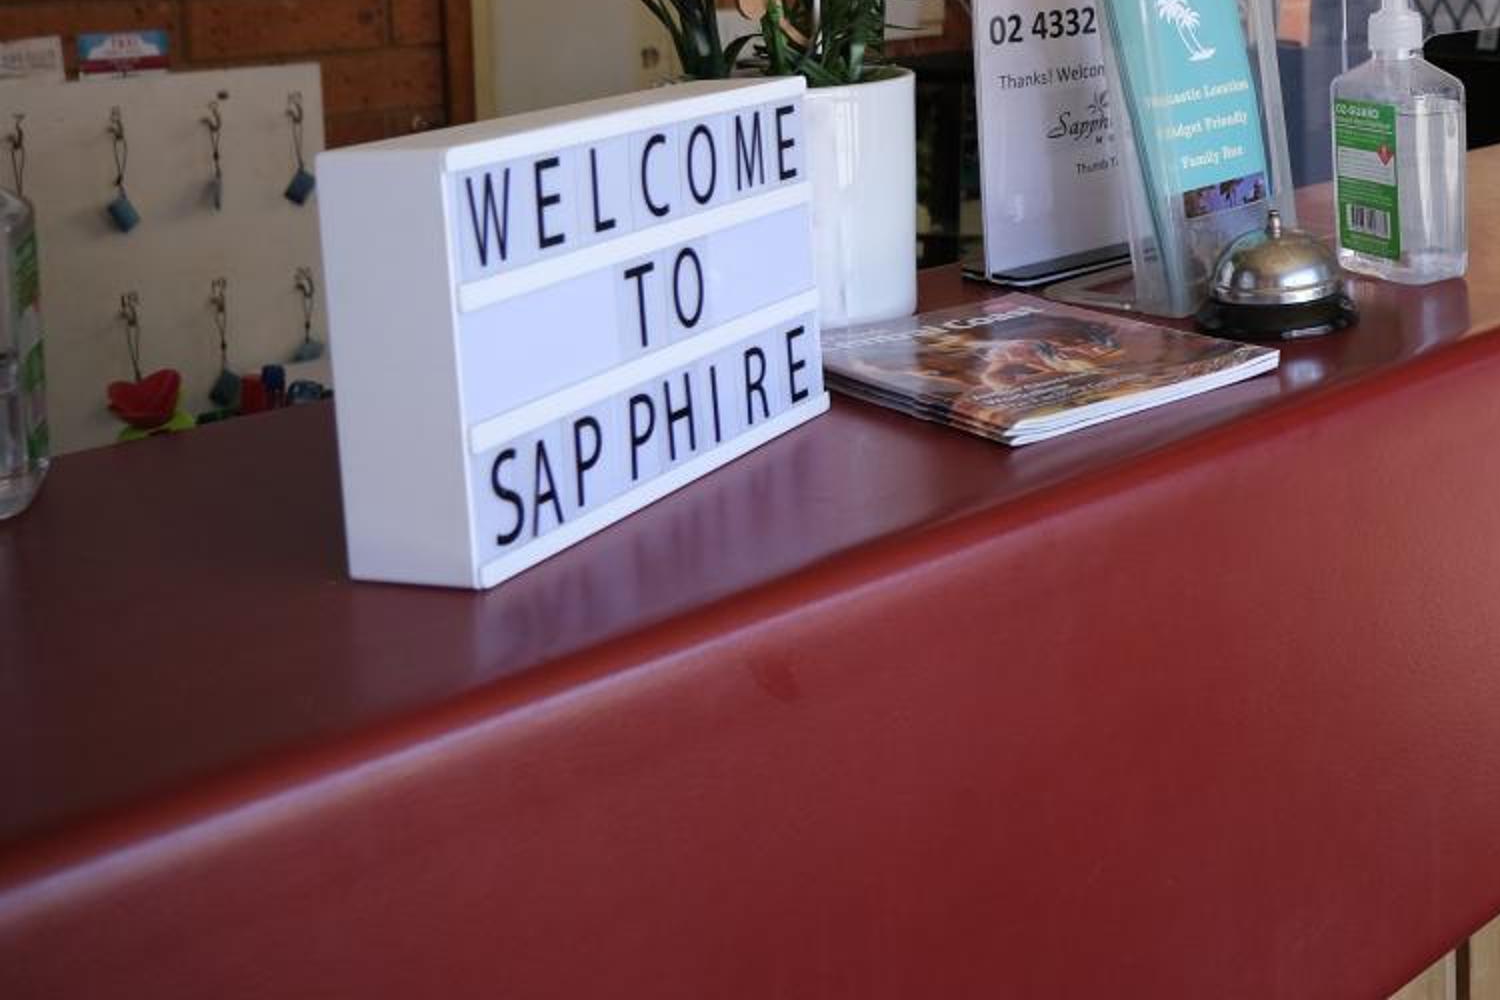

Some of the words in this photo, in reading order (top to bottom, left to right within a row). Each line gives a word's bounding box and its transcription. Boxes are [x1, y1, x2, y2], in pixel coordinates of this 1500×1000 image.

[989, 12, 1024, 46] 02
[1031, 6, 1097, 40] 4332
[996, 70, 1053, 89] Thanks!
[1055, 63, 1105, 83] Welcom
[1203, 79, 1249, 99] Location
[1046, 111, 1109, 141] Sapph
[1203, 109, 1249, 131] Friendly
[1182, 148, 1219, 169] Family
[465, 104, 798, 267] WELCOME
[623, 246, 705, 348] TO
[943, 305, 1044, 330] Coast
[490, 325, 810, 547] SAPPHIRE
